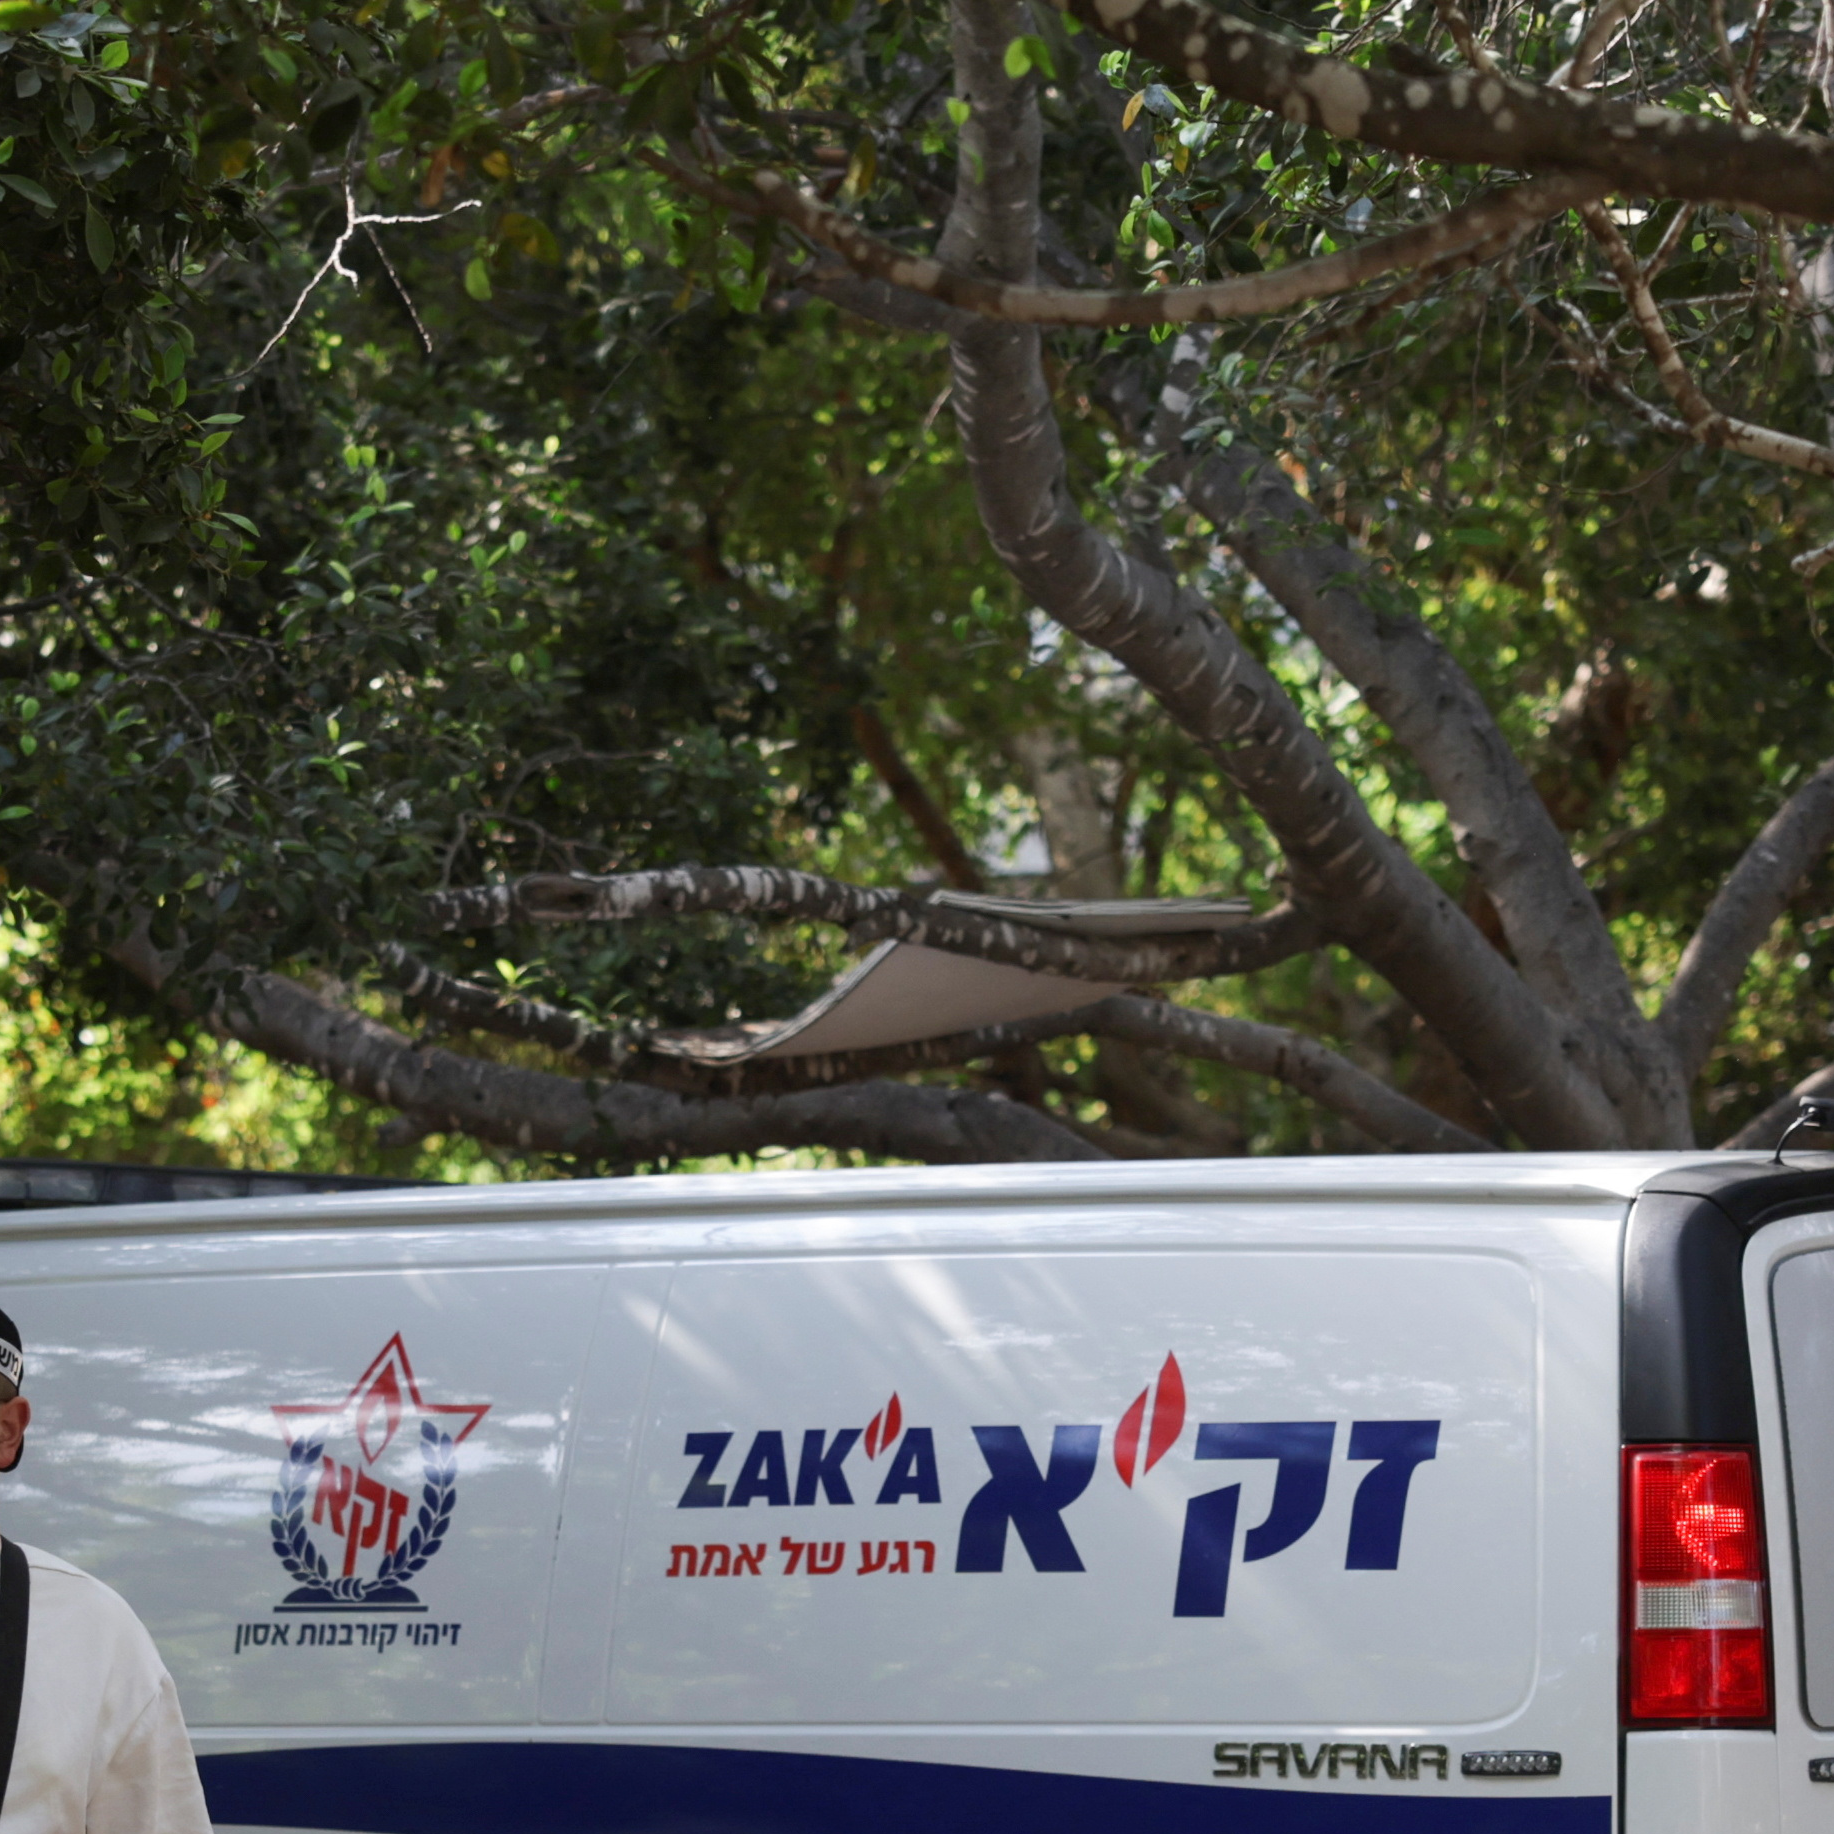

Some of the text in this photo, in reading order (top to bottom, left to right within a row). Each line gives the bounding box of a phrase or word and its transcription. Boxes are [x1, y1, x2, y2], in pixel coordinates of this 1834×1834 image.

[666, 1536, 936, 1578] רגע של אמת
[234, 1622, 461, 1655] זיהוי קורבנות אסון
[1212, 1742, 1449, 1780] SAVANA
